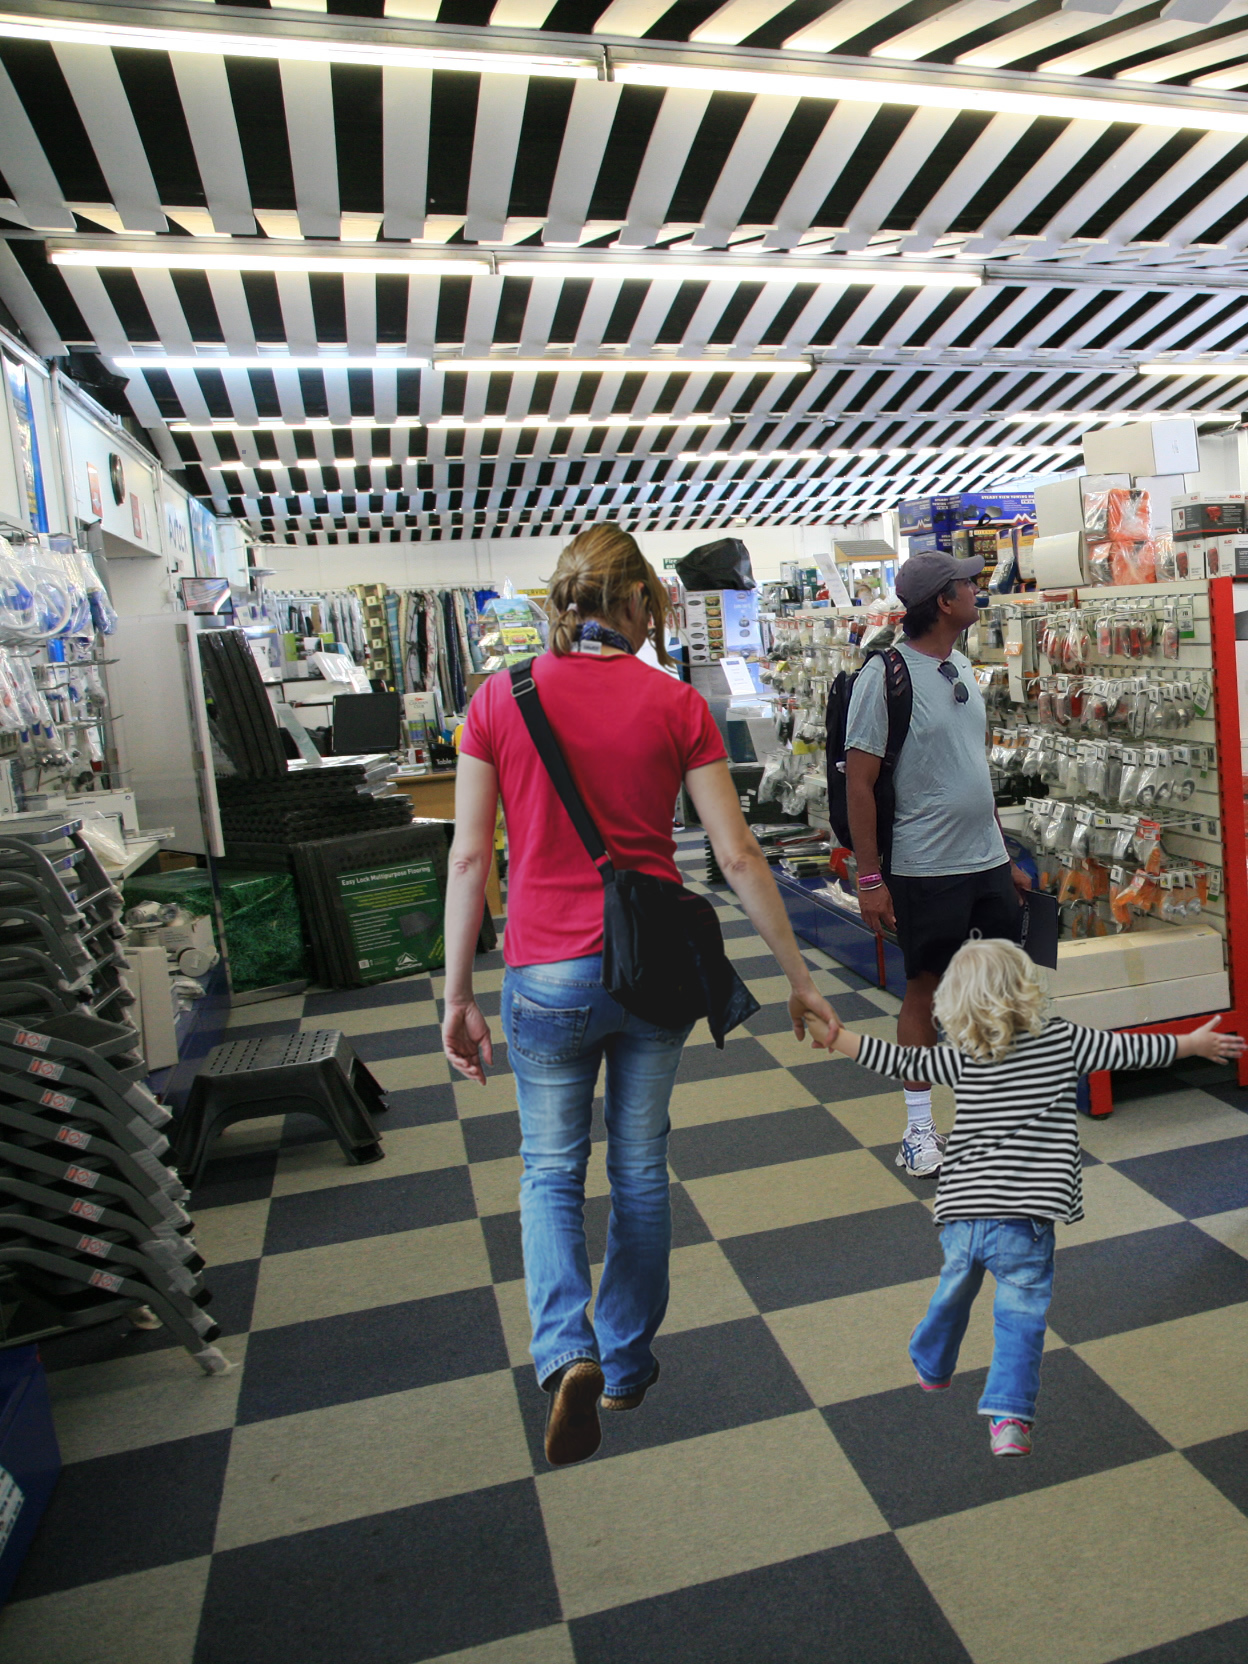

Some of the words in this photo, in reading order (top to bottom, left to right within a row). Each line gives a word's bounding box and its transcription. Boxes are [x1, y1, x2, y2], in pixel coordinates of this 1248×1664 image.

[341, 879, 356, 887] Easy
[356, 876, 371, 884] Lock
[370, 869, 407, 881] Multipurpose
[407, 866, 431, 875] Flooring
